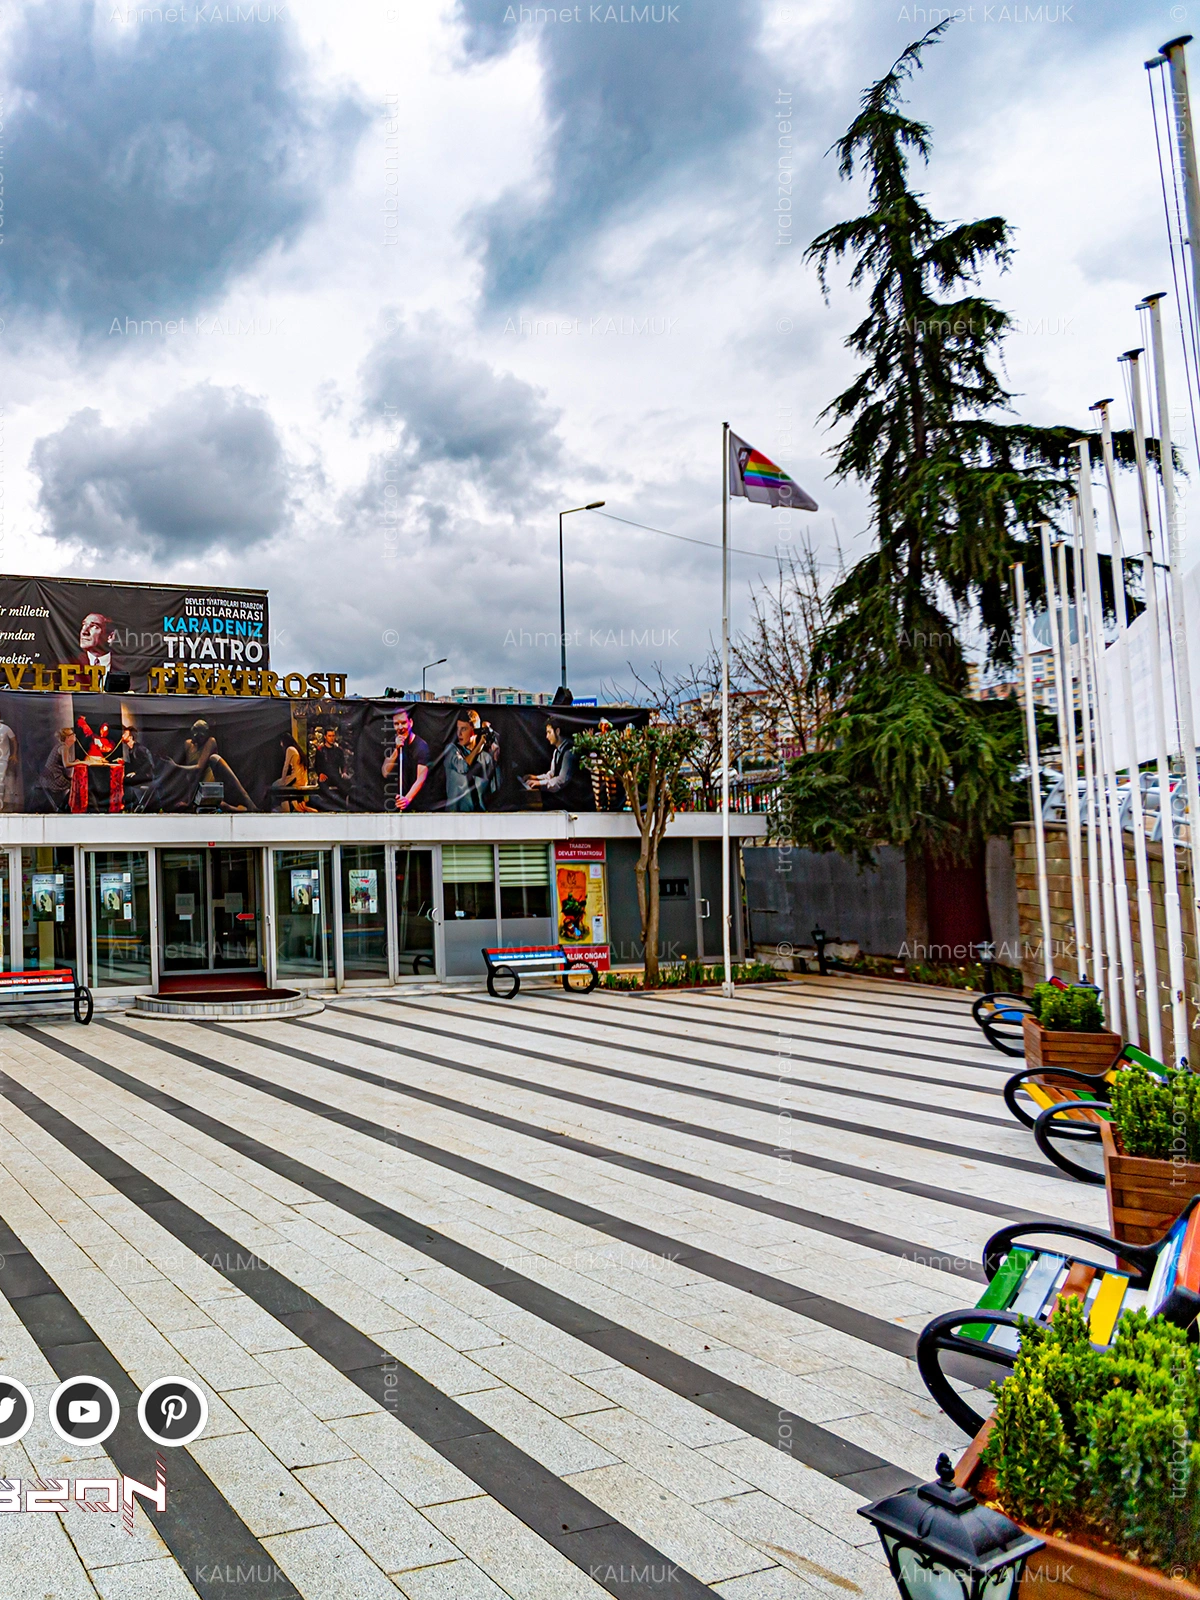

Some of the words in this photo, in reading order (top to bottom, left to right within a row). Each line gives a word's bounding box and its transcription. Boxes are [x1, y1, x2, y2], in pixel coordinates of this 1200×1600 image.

[185, 597, 205, 606] DEVLET
[206, 597, 239, 608] TİYATROLARI
[240, 601, 264, 610] TRABZON
[8, 605, 50, 618] milletin
[185, 606, 263, 621] ULUSLARARASI
[151, 663, 348, 698] TİYATROSU
[584, 952, 607, 960] ONGAN
